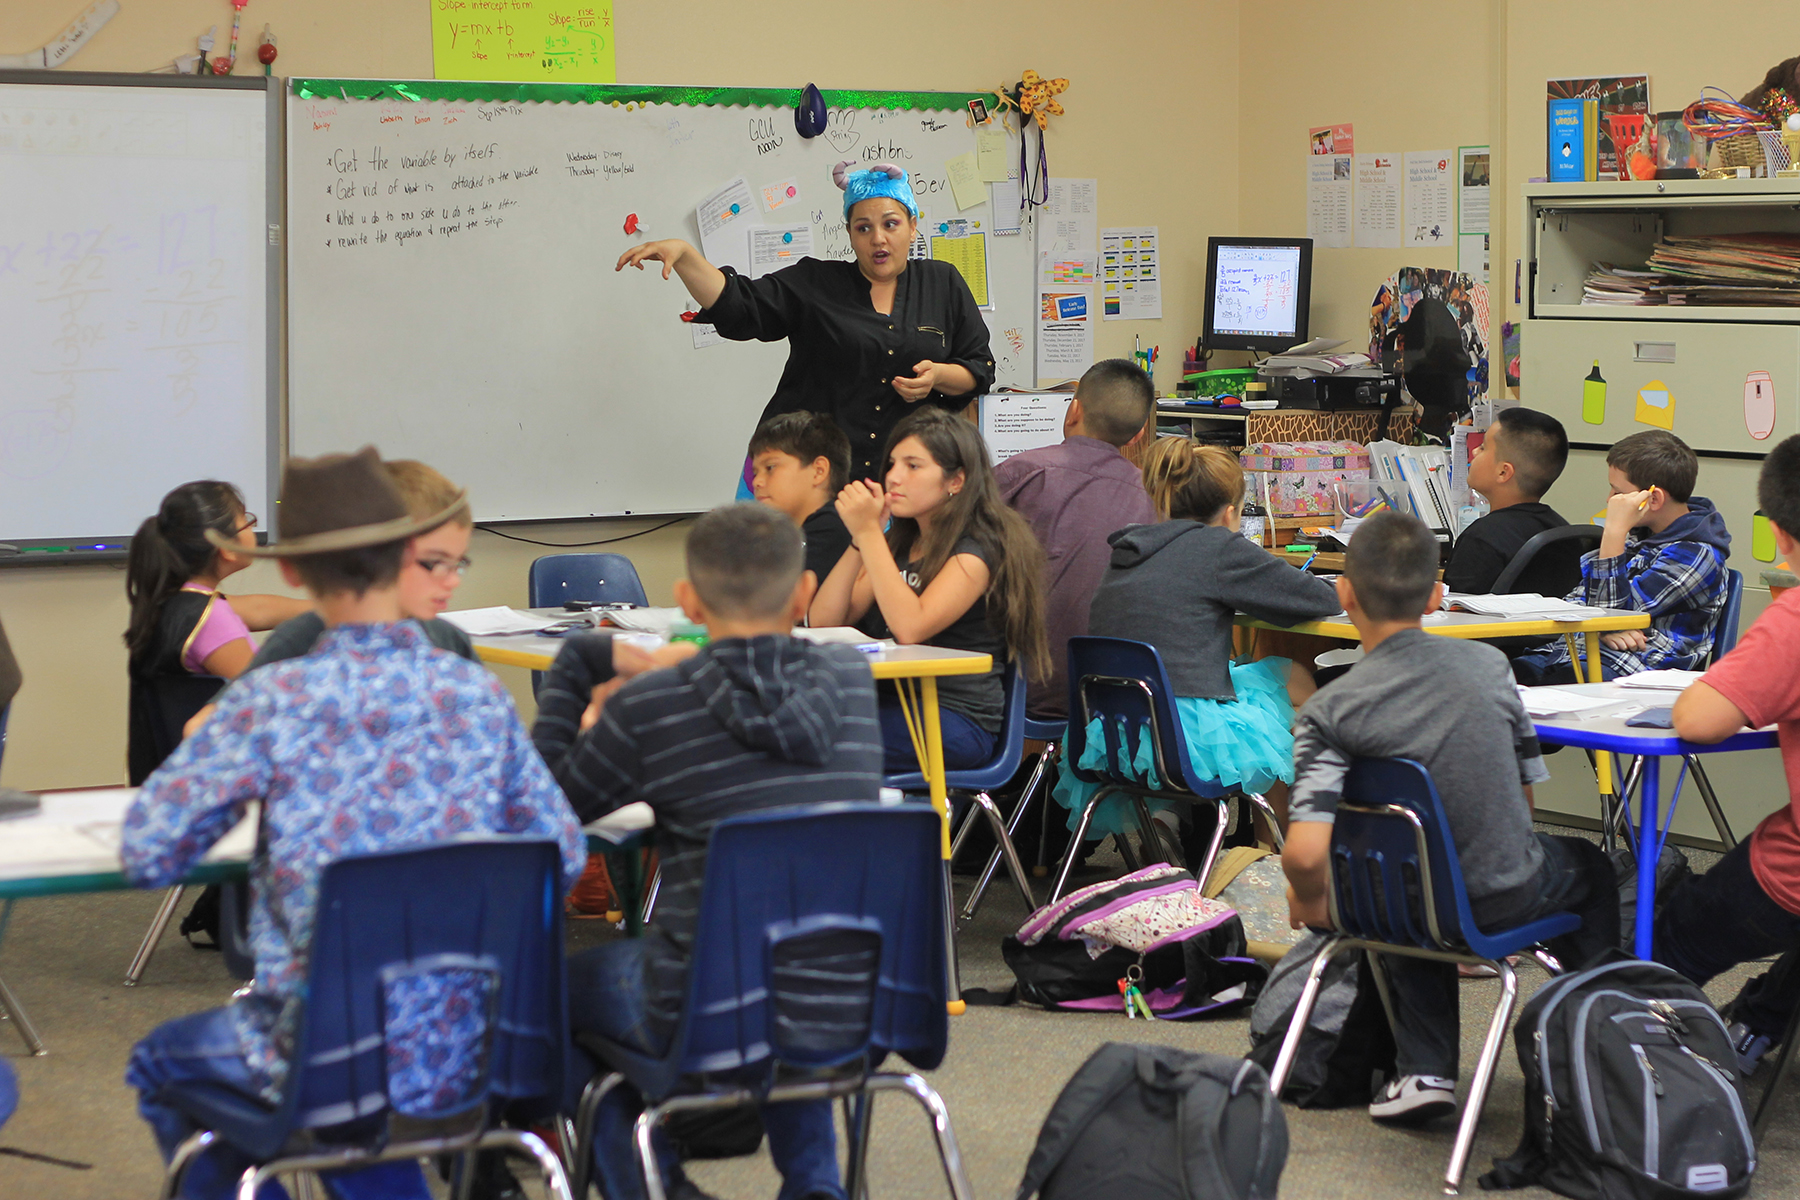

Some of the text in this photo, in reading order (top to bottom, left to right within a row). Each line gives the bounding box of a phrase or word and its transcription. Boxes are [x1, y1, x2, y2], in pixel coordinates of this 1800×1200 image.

[577, 8, 595, 16] rise
[579, 19, 596, 28] run
[472, 50, 488, 61] Slope
[334, 148, 358, 173] Get
[368, 145, 389, 171] the
[400, 150, 438, 169] variable
[443, 147, 456, 168] by
[1419, 166, 1433, 174] School
[336, 177, 357, 200] Get
[363, 181, 378, 197] rid
[387, 178, 399, 195] of
[424, 180, 434, 192] is
[451, 175, 484, 190] attached
[487, 174, 495, 185] to
[497, 170, 509, 182] the
[371, 210, 380, 224] do
[386, 210, 394, 221] to
[420, 207, 435, 220] side
[467, 204, 475, 215] to
[337, 232, 368, 248] rewrite
[375, 229, 388, 244] the
[394, 226, 423, 247] equation
[439, 221, 461, 238] repeat
[466, 220, 478, 231] the
[484, 215, 504, 229] steps
